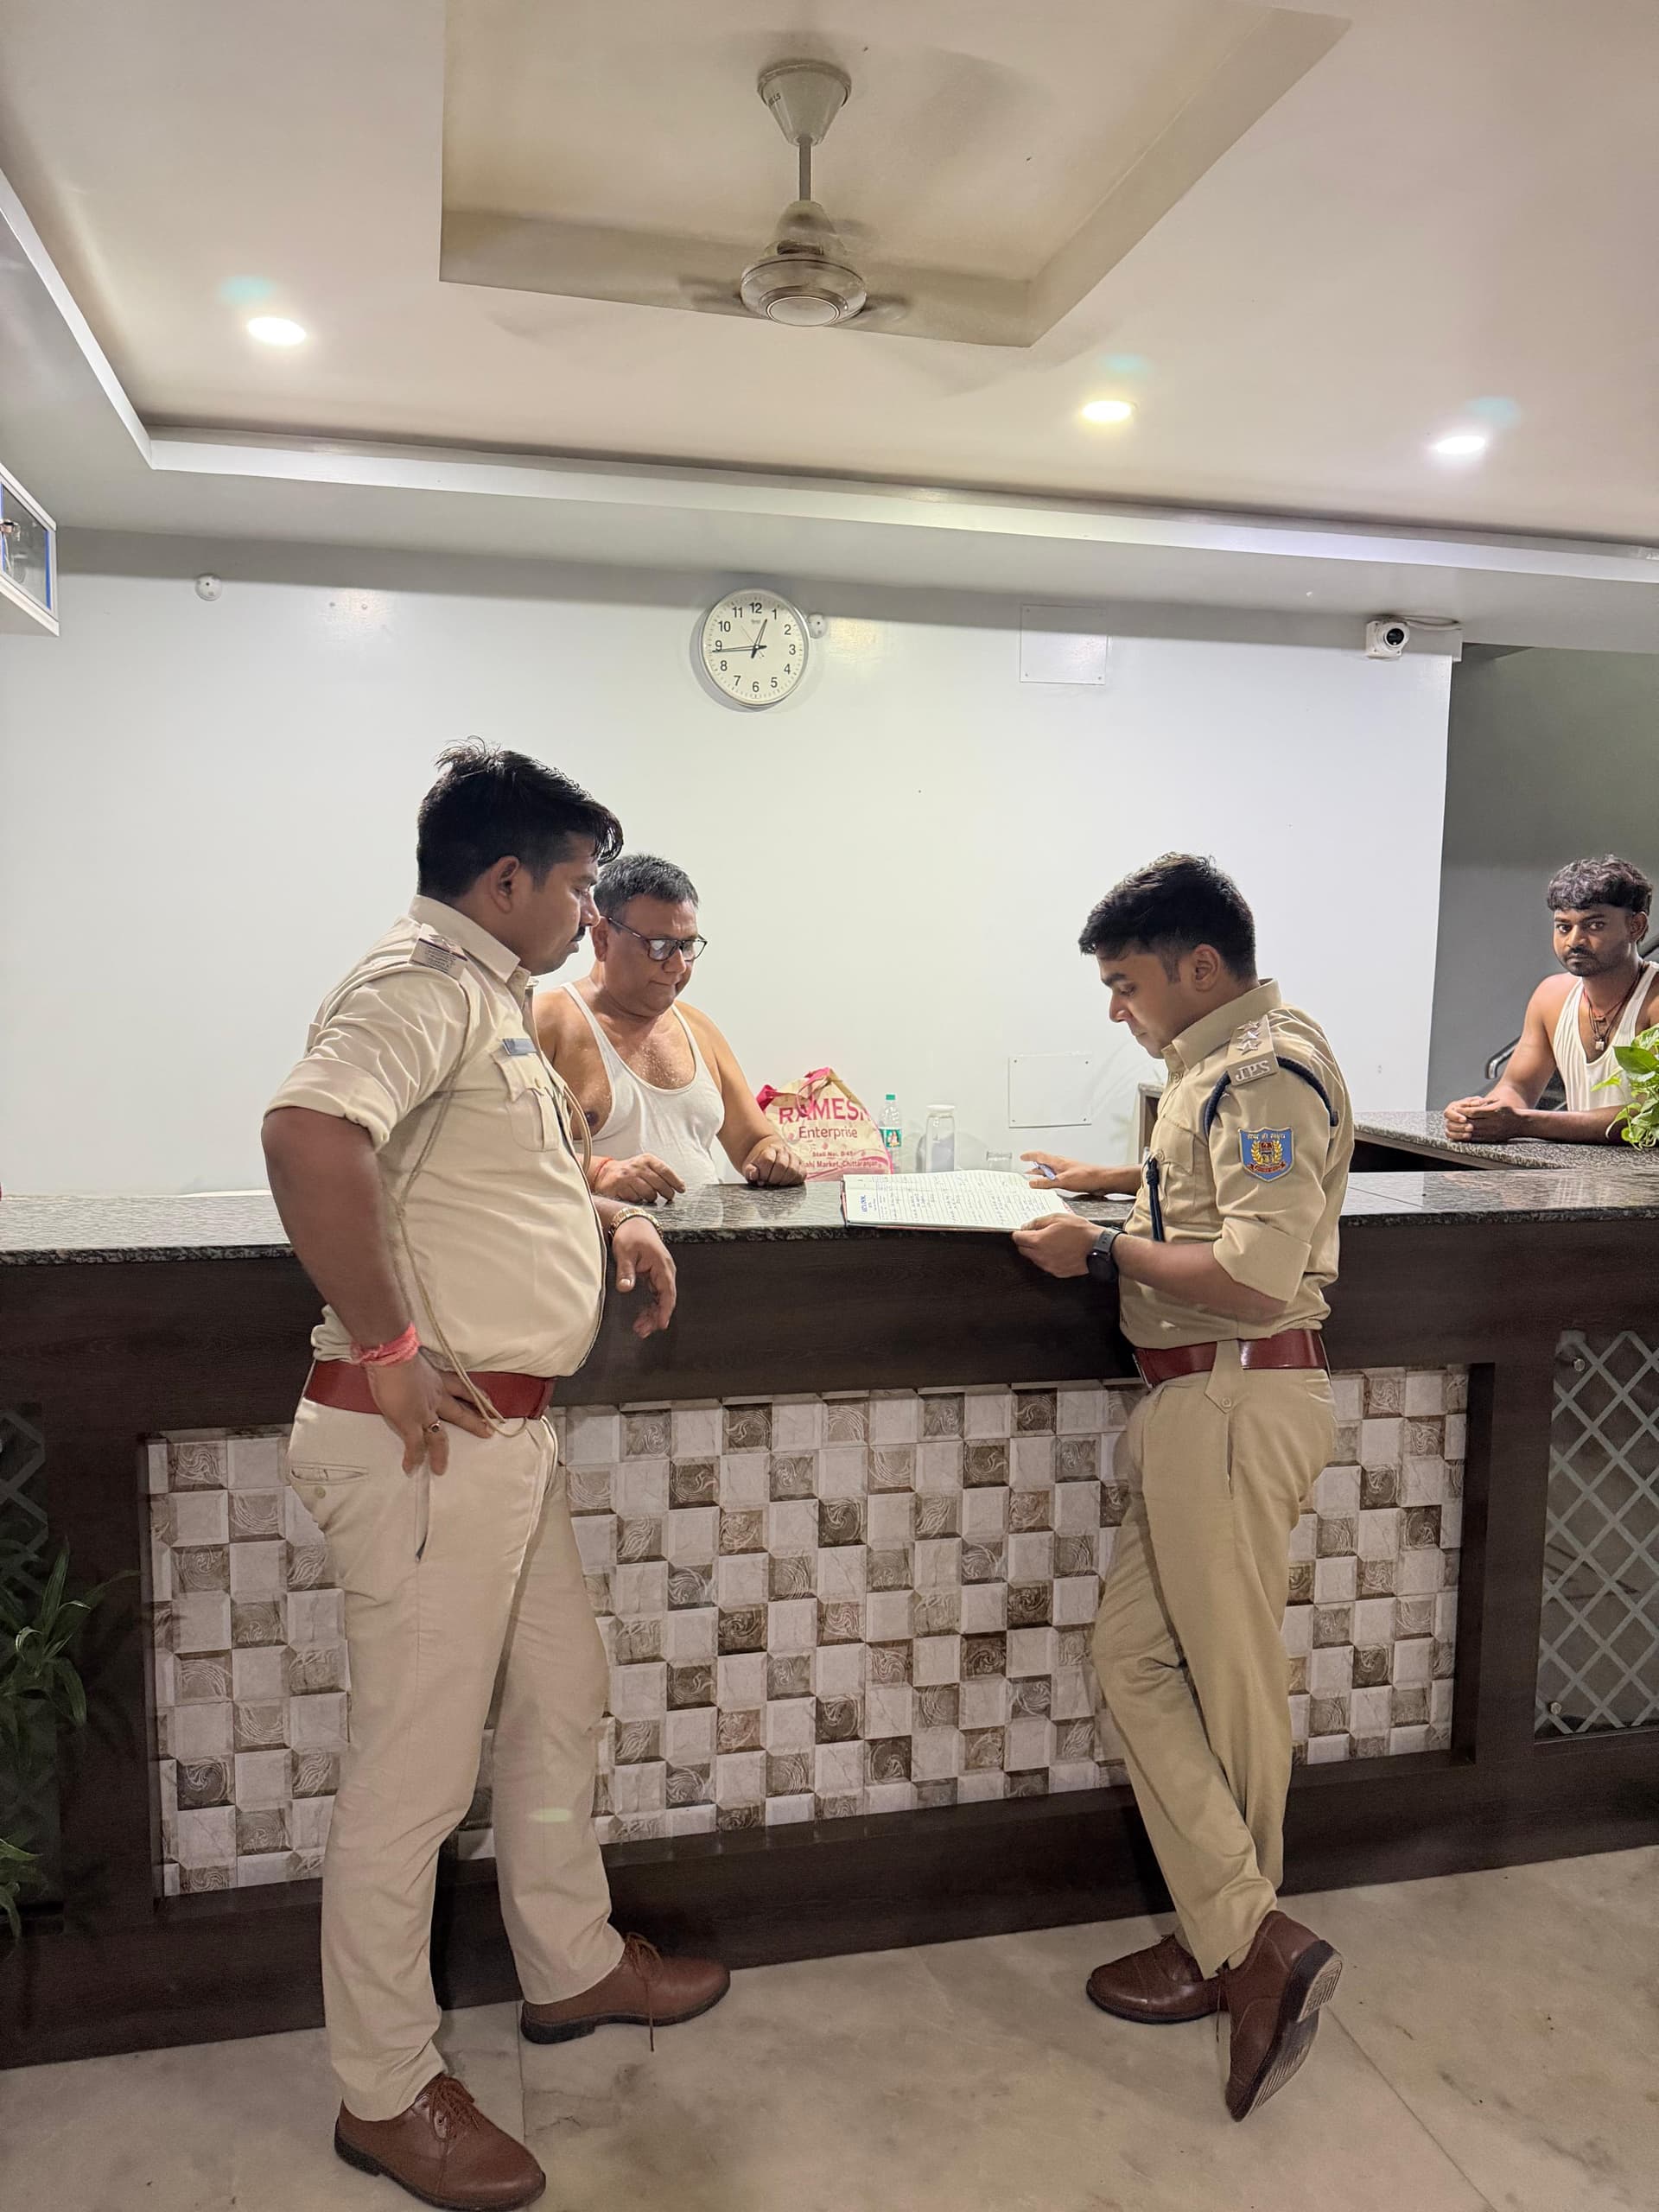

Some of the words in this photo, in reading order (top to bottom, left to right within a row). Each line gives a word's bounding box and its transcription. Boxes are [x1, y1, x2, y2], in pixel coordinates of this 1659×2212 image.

[733, 607, 743, 618] 11
[749, 602, 762, 613] 12
[772, 608, 777, 620] 1
[718, 620, 731, 632] 10
[784, 624, 791, 635] 2
[715, 640, 722, 652] 9
[789, 644, 796, 655] 3
[720, 660, 728, 671] 8
[784, 663, 791, 674] 4
[734, 675, 741, 686] 7
[771, 677, 778, 688] 5
[752, 681, 760, 692] 6
[1235, 1059, 1270, 1082] JPS
[798, 1126, 858, 1140] Enterprise
